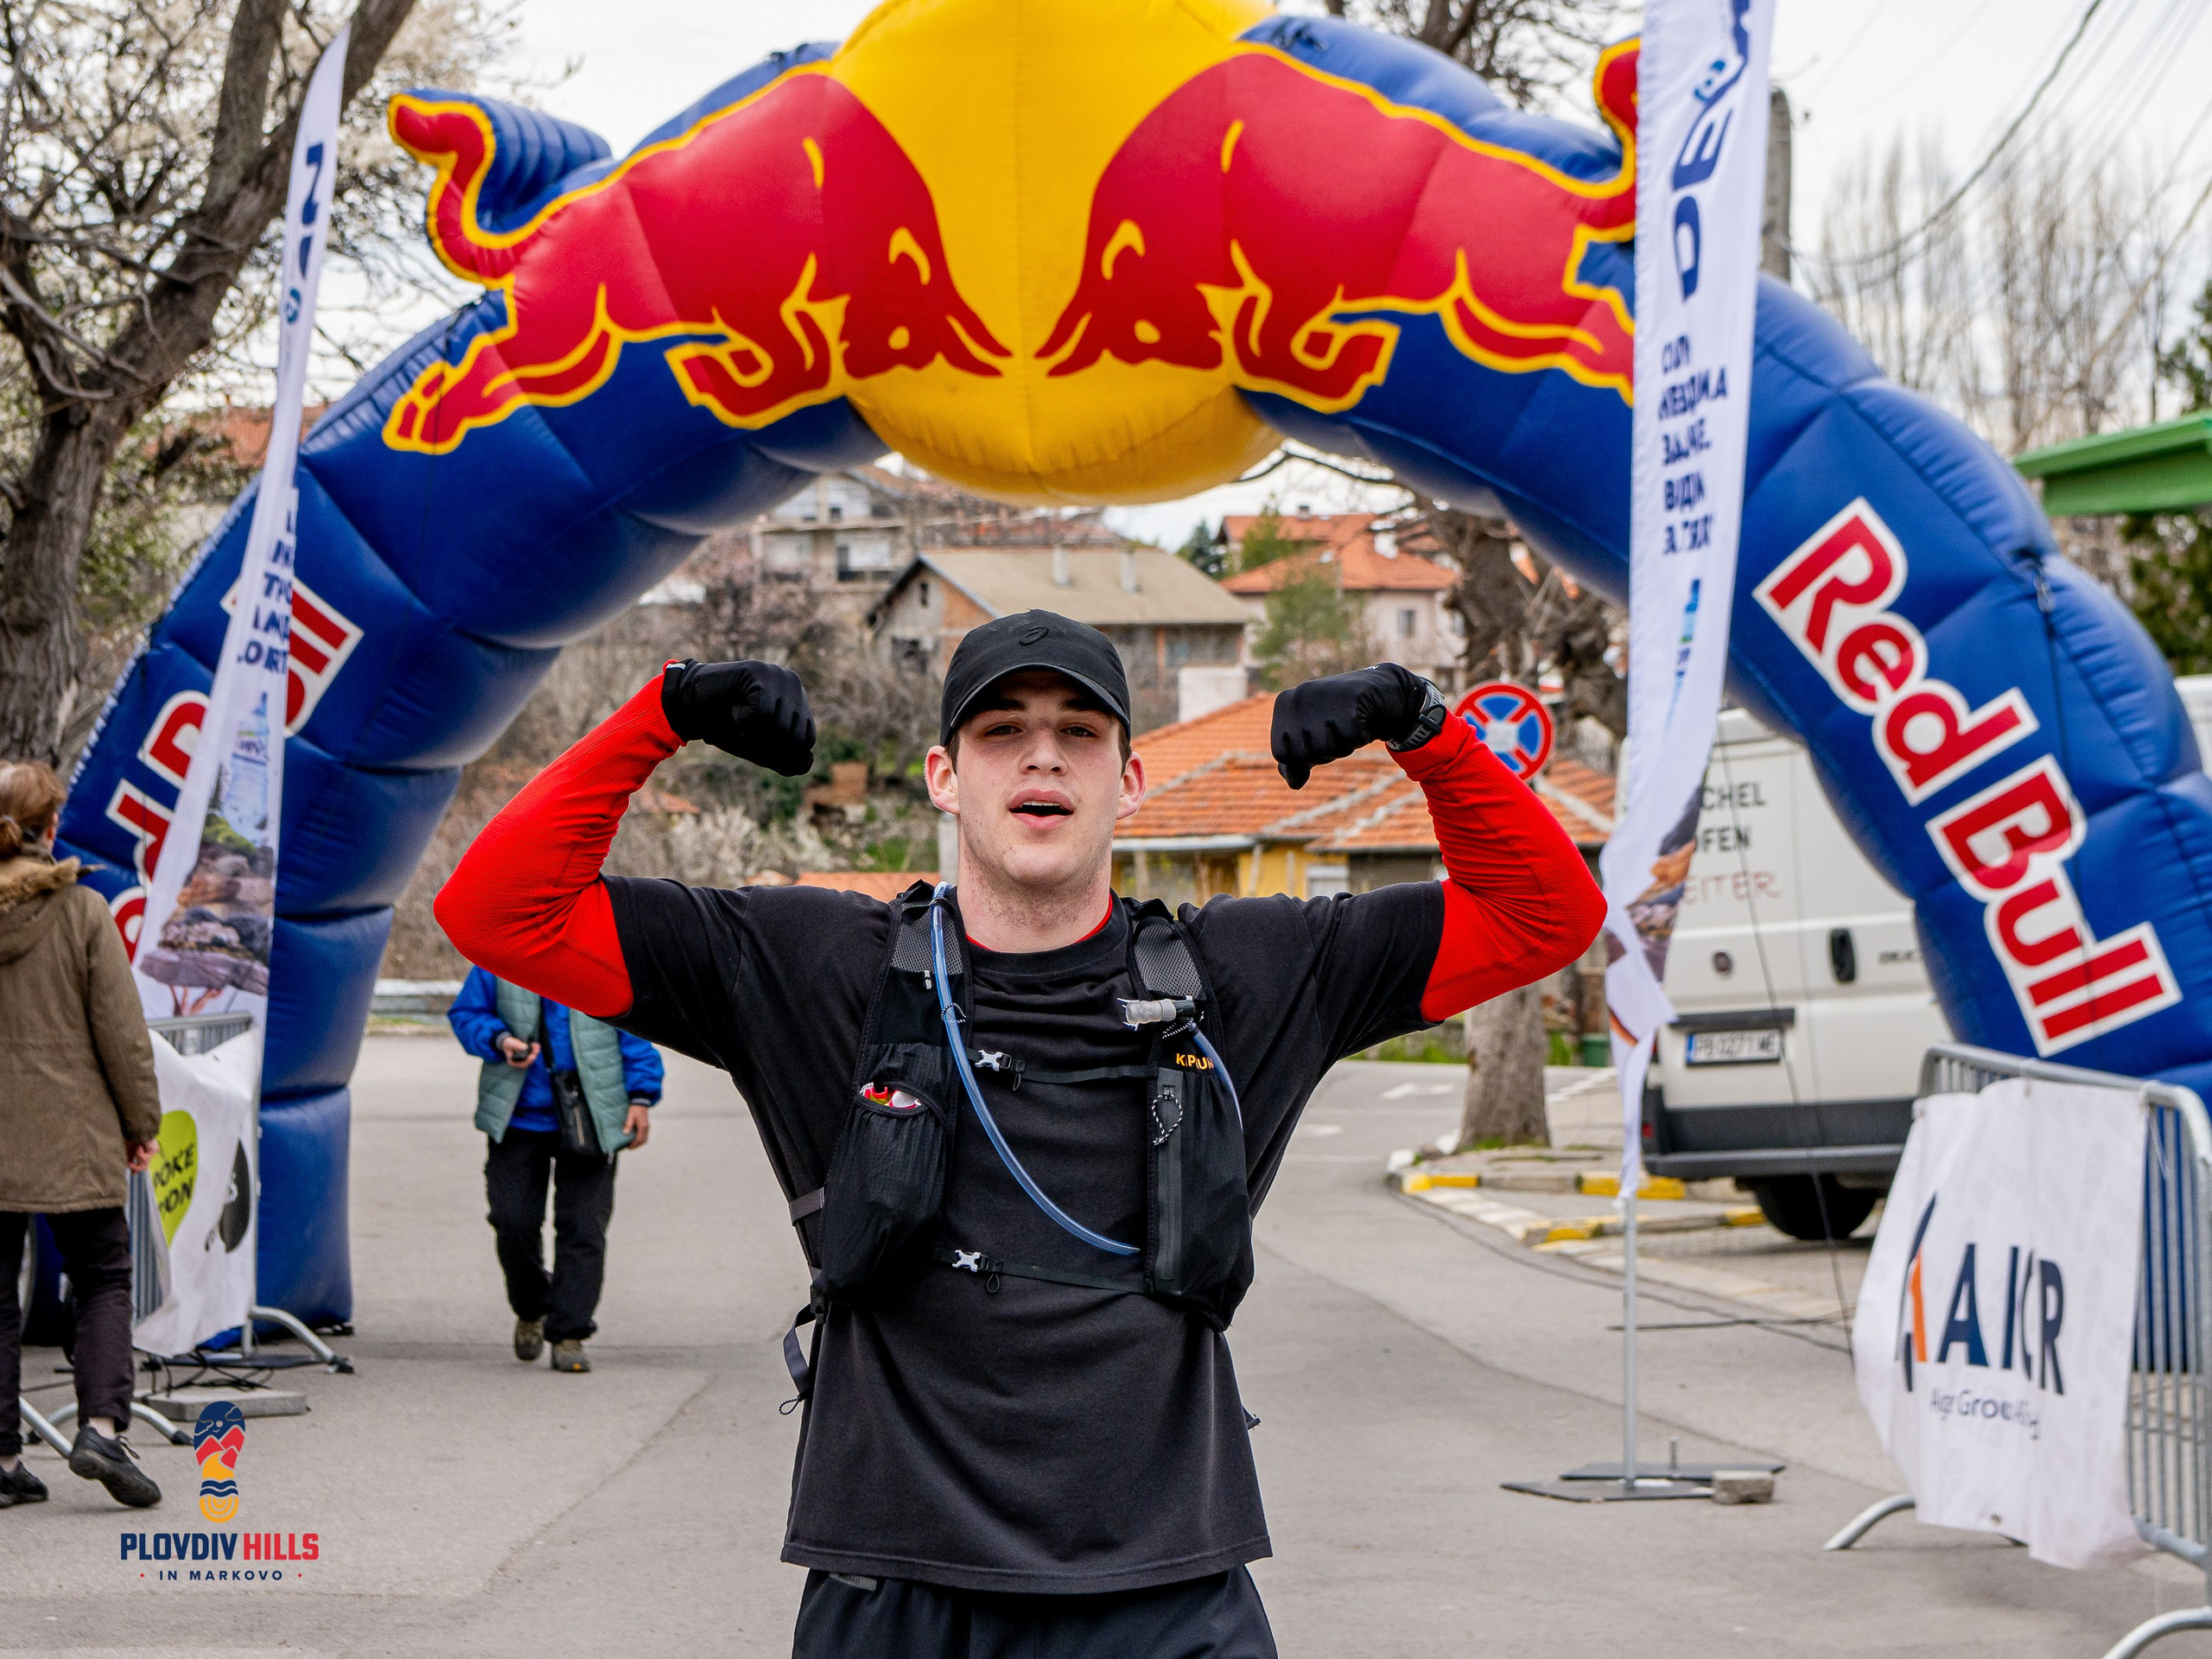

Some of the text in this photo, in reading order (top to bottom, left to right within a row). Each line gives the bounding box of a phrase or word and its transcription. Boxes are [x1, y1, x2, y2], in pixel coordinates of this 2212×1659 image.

[1702, 781, 1766, 810] CHEL
[1763, 508, 2171, 1048] Red Bull
[1683, 870, 1782, 906] EITER
